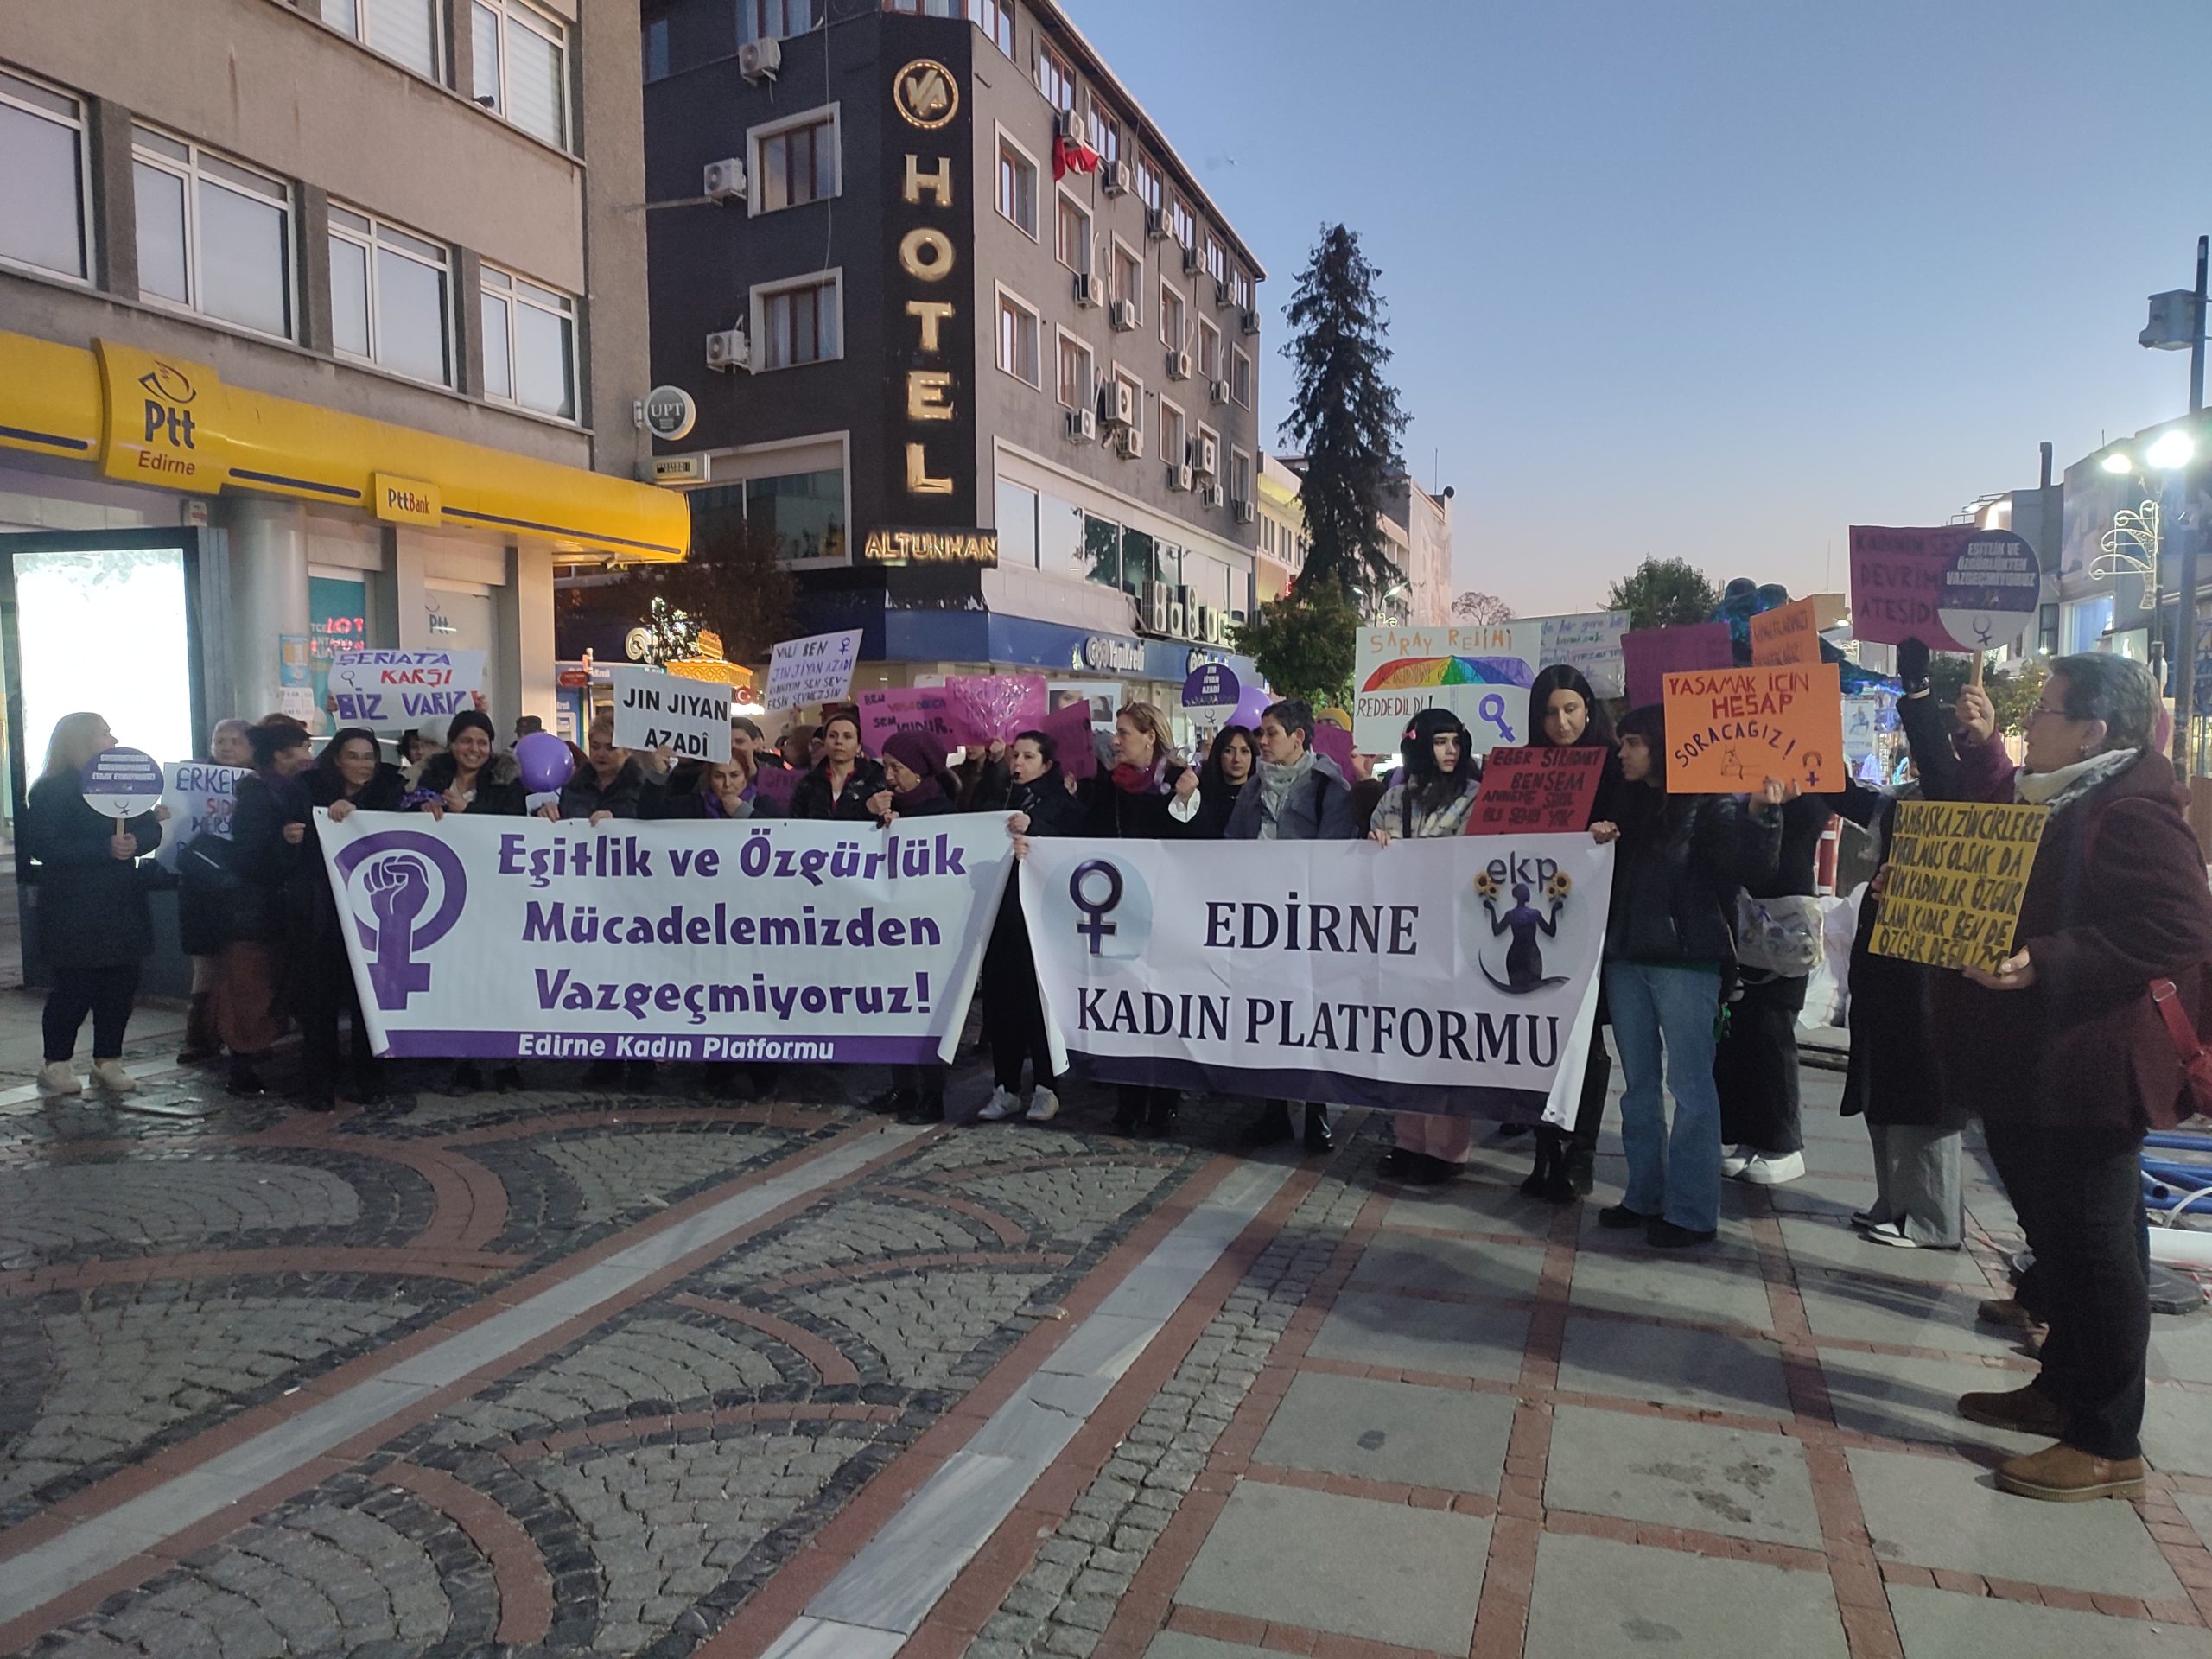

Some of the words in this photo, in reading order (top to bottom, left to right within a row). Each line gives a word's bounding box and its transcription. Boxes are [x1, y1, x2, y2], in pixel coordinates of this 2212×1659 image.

[899, 154, 954, 494] HOTEL
[144, 398, 195, 449] Ptt
[651, 402, 683, 417] UPT
[138, 450, 195, 475] Edirne
[388, 487, 429, 514] PttBank
[803, 640, 828, 658] BEN
[1370, 630, 1433, 655] SARAY
[380, 668, 453, 687] KARŞI
[335, 687, 388, 720] BİZ
[623, 688, 659, 711] JIN
[667, 692, 728, 721] JIYAN
[1712, 692, 1793, 719] HESAP
[645, 728, 709, 757] AZADÎ
[498, 833, 652, 887] Eşitlik
[668, 848, 720, 877] ve
[740, 828, 967, 887] Özgürlük
[1486, 851, 1558, 893] ekp
[1996, 846, 2024, 877] DA
[522, 901, 941, 947] Mücadelemizden
[1204, 891, 1419, 956] EDİRNE
[1952, 910, 1987, 941] BEN
[1983, 918, 2012, 948] DE
[535, 968, 931, 1025] Vazgeçmiyoruz!
[1077, 987, 1230, 1041] KADIN
[1245, 998, 1560, 1068] PLATFORMU
[518, 1033, 605, 1057] Edirne
[616, 1035, 691, 1059] Kadın
[703, 1037, 835, 1060] Platformu
